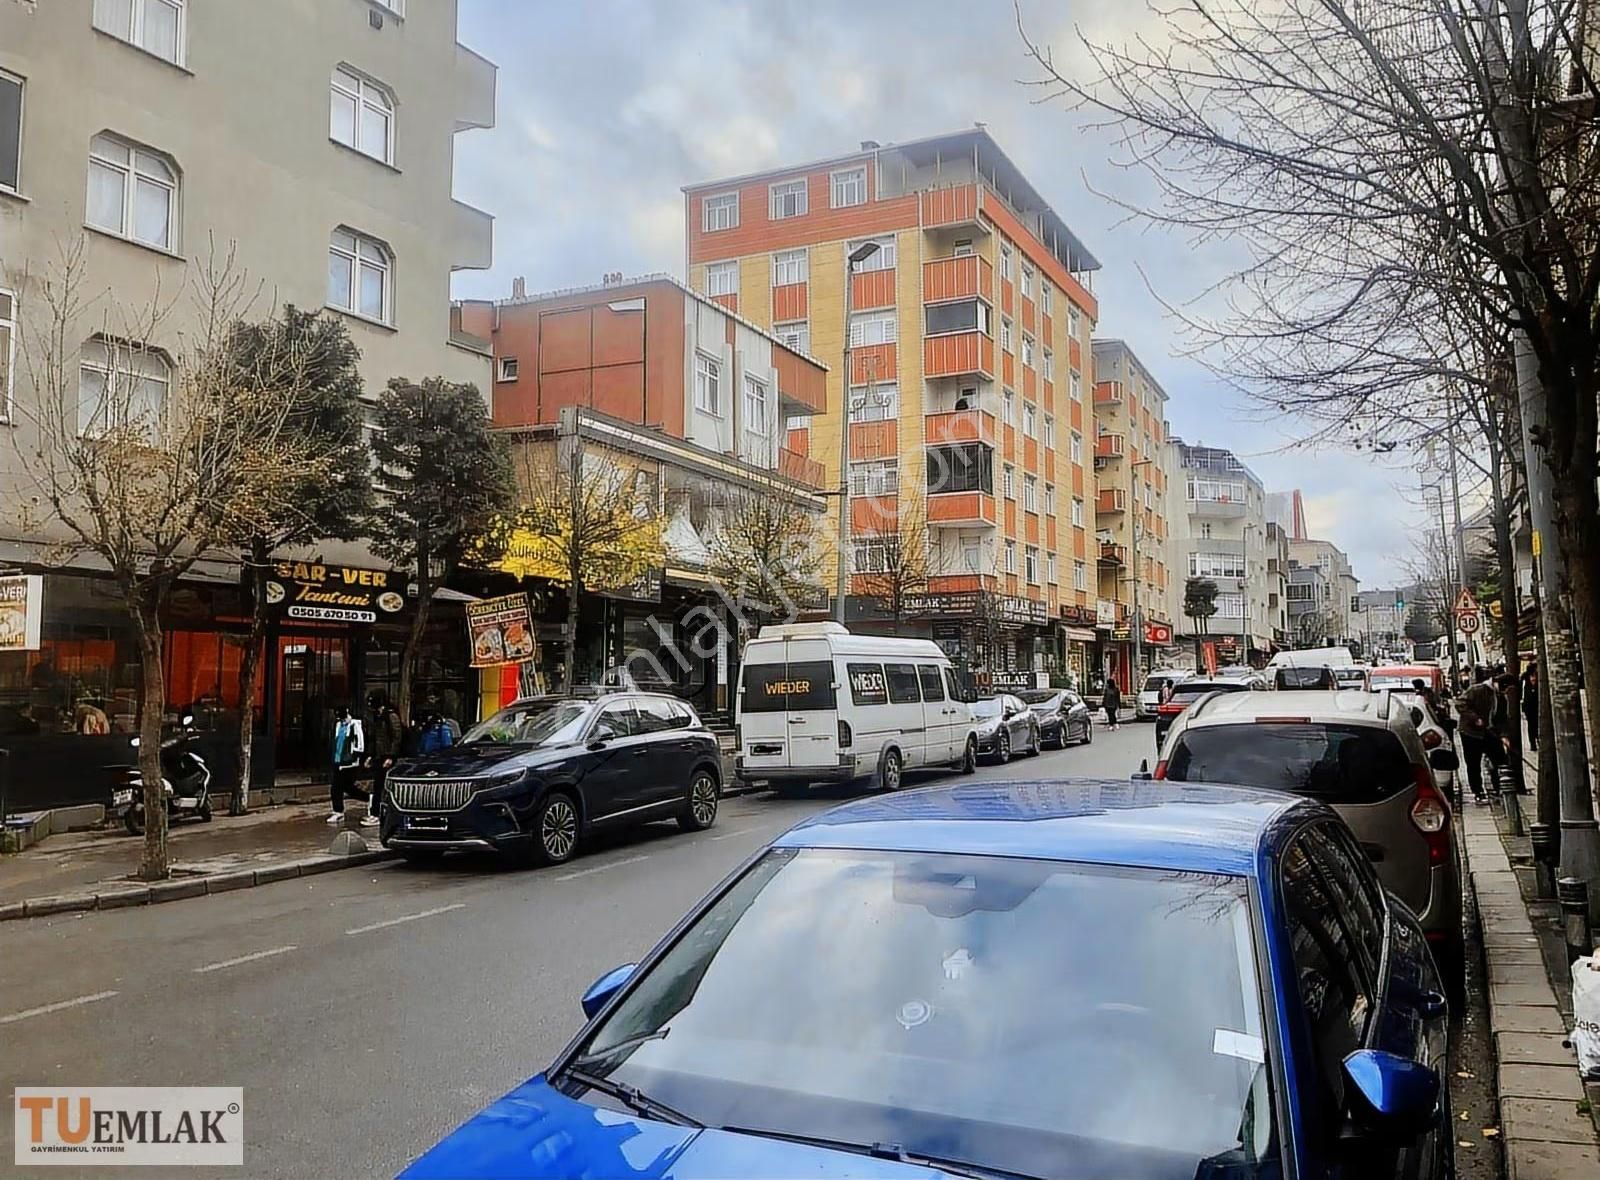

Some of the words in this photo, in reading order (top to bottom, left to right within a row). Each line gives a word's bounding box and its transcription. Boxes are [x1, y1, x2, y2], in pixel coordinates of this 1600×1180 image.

[295, 581, 371, 606] Tantuni
[292, 607, 322, 618] 0505
[1461, 617, 1475, 629] 30
[765, 680, 810, 695] WIEDER
